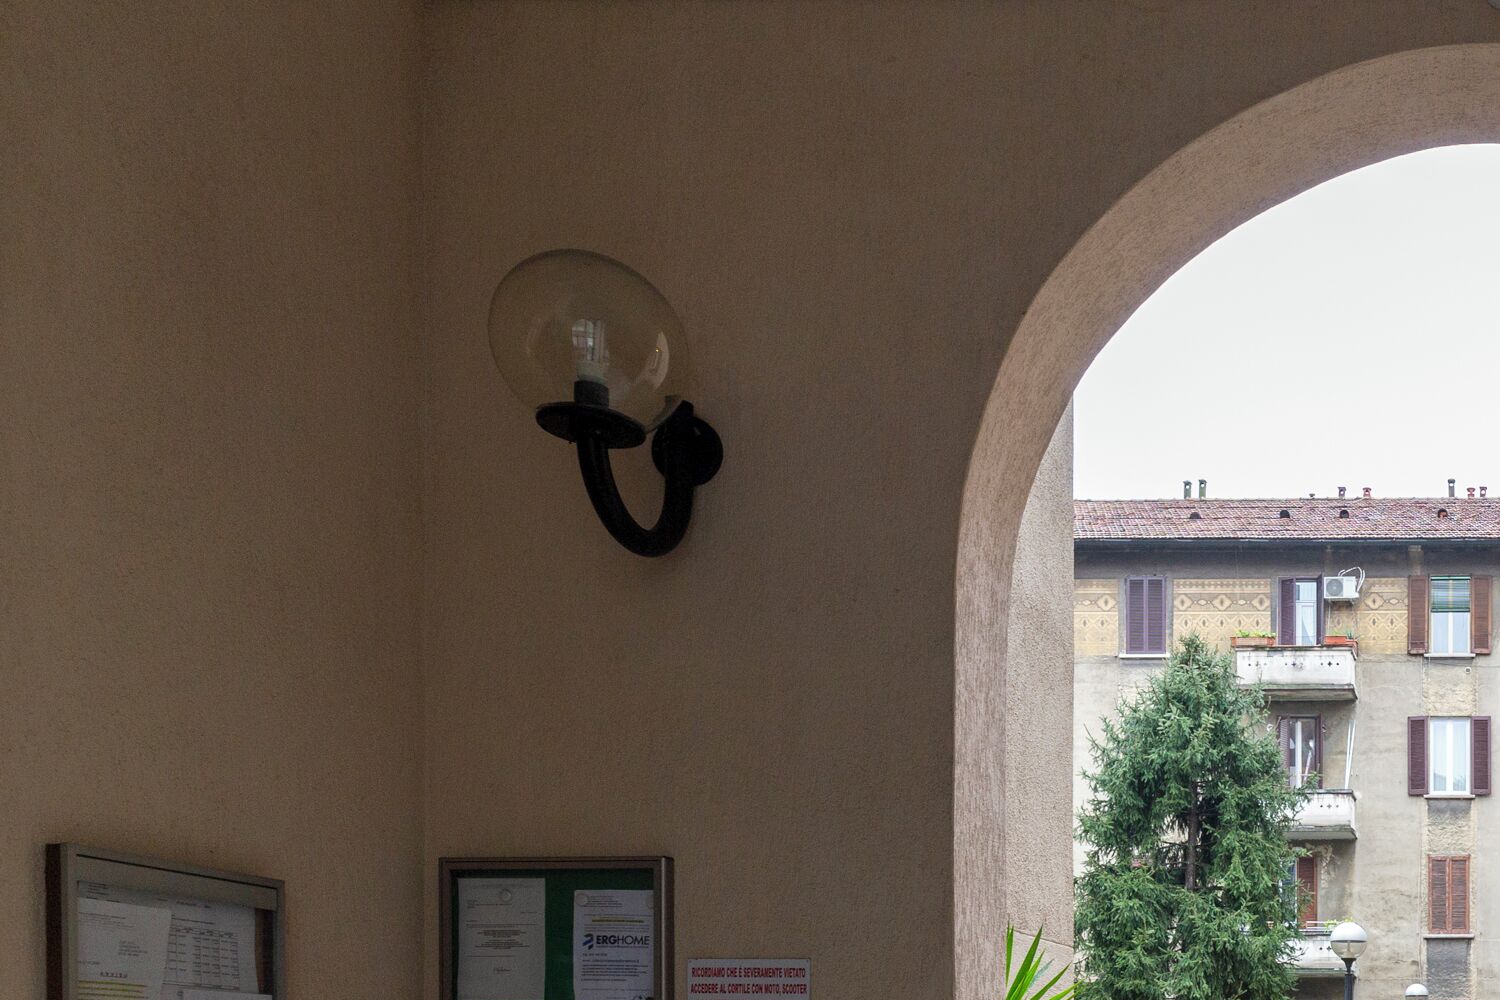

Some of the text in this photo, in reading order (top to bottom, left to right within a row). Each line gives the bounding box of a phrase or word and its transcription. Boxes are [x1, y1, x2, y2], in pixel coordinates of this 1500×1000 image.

[691, 967, 725, 978] RICORDIAMO
[726, 967, 738, 978] CHE
[743, 967, 782, 978] SEVERAMENTE
[783, 967, 806, 978] VIETATO
[690, 983, 718, 994] ACCEDERE
[719, 983, 727, 994] AL
[728, 983, 751, 994] CORTILE
[751, 983, 763, 994] CON
[782, 983, 807, 994] SCOOTER
